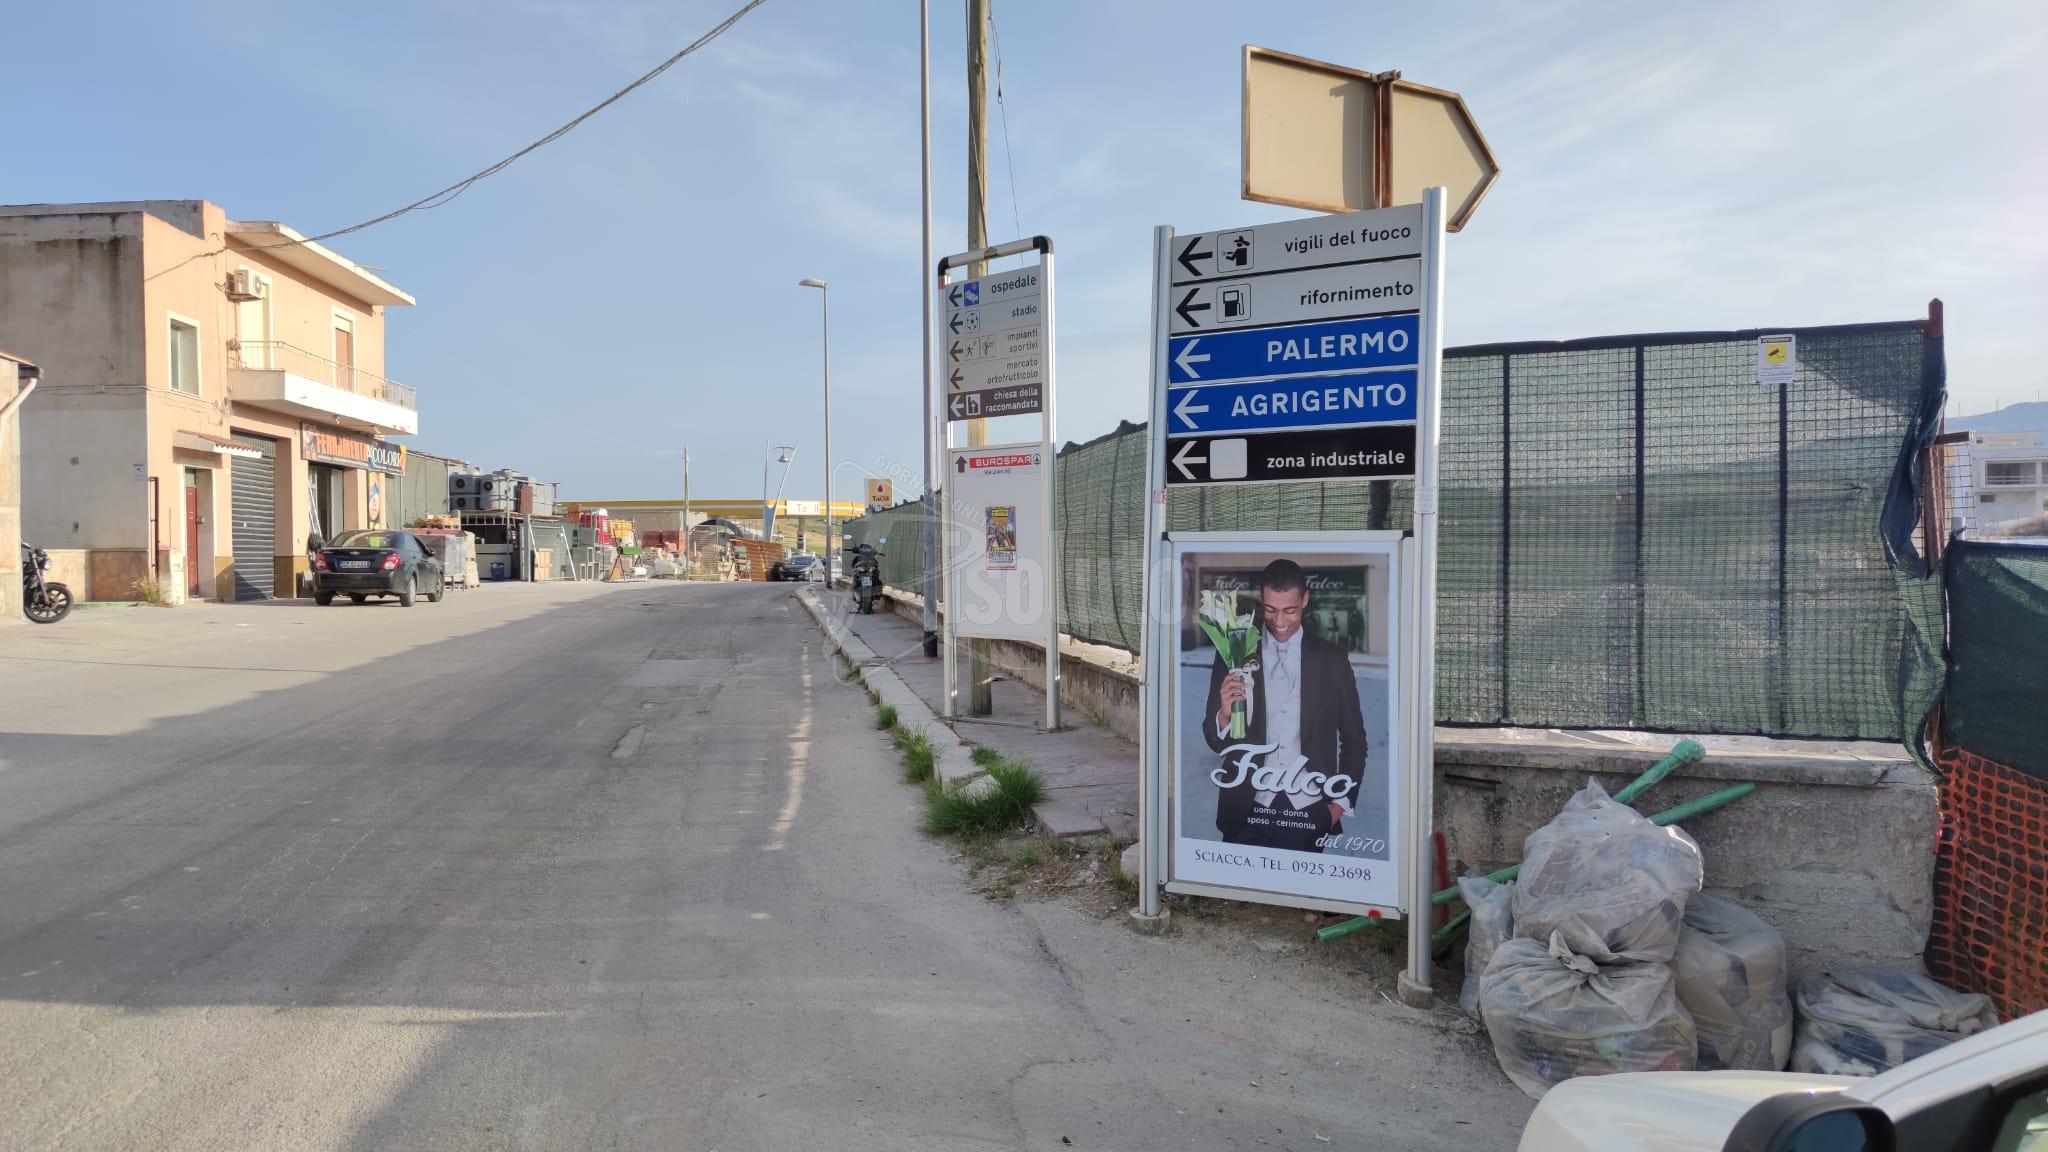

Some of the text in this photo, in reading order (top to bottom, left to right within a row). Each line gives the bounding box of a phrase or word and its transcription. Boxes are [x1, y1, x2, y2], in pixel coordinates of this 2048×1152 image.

[1285, 226, 1411, 253] vigili del fuoco
[991, 276, 1037, 294] ospedale
[1300, 280, 1414, 306] rifornimento
[1011, 304, 1038, 318] stadio
[1007, 327, 1038, 341] impianti
[1009, 340, 1038, 353] sportivi
[1267, 329, 1409, 362] PALERMO
[1006, 359, 1038, 370] mercato
[987, 369, 1038, 384] ortofrutticolo
[993, 387, 1038, 401] chiesa della
[1231, 383, 1407, 417] AGRIGENTO
[985, 399, 1038, 413] raccomandata
[372, 448, 400, 466] COLORI
[975, 455, 1031, 467] EUROSPAR
[1267, 448, 1405, 468] zona industriale
[1210, 741, 1357, 799] Falco
[1254, 806, 1277, 815] uomo
[1283, 808, 1309, 818] donna
[1247, 816, 1270, 826] sposo
[1276, 819, 1316, 830] cerimonia
[1315, 832, 1386, 854] dal 1970
[1292, 859, 1325, 876] 0925
[1329, 864, 1372, 881] 23698
